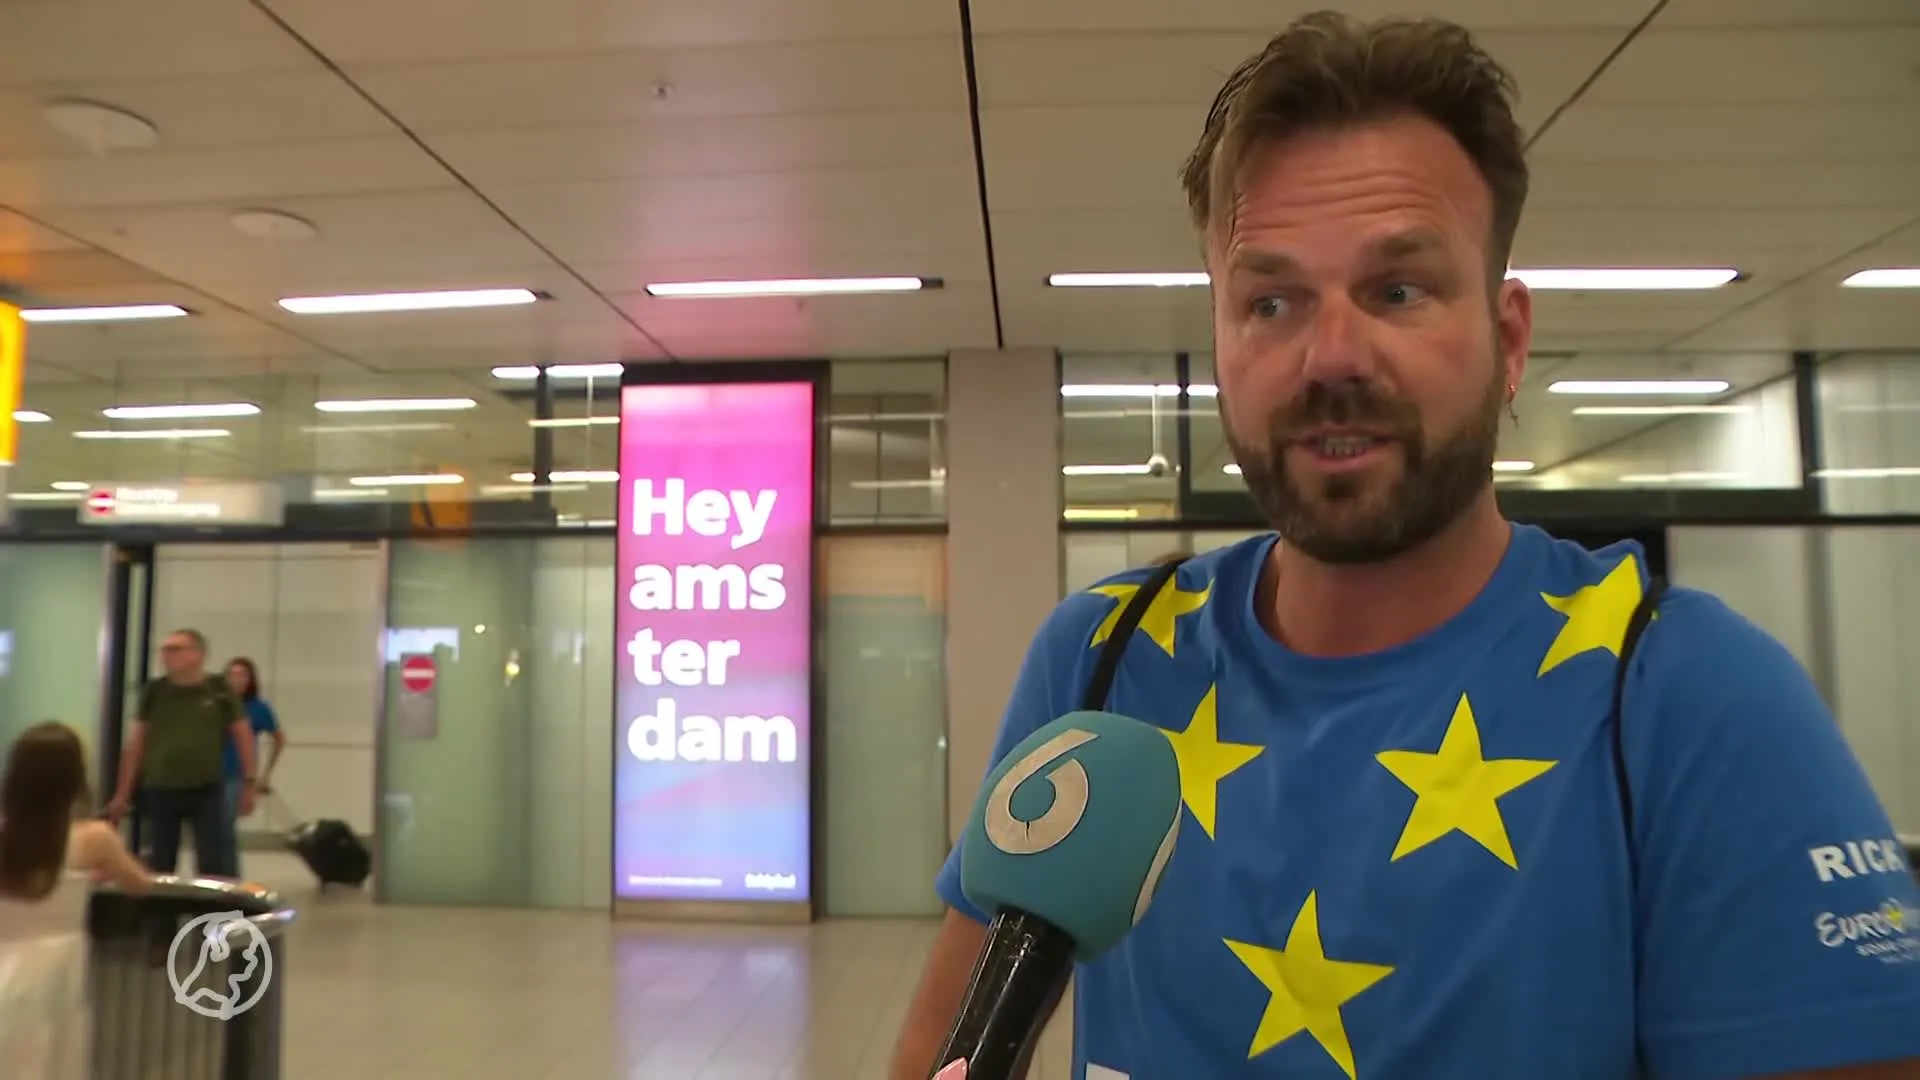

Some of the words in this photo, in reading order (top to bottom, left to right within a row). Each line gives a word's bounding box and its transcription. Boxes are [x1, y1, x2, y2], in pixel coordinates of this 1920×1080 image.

[631, 477, 778, 550] Hey
[628, 563, 787, 611] ams
[626, 626, 741, 687] ter
[626, 697, 798, 763] dam
[984, 727, 1101, 856] 6
